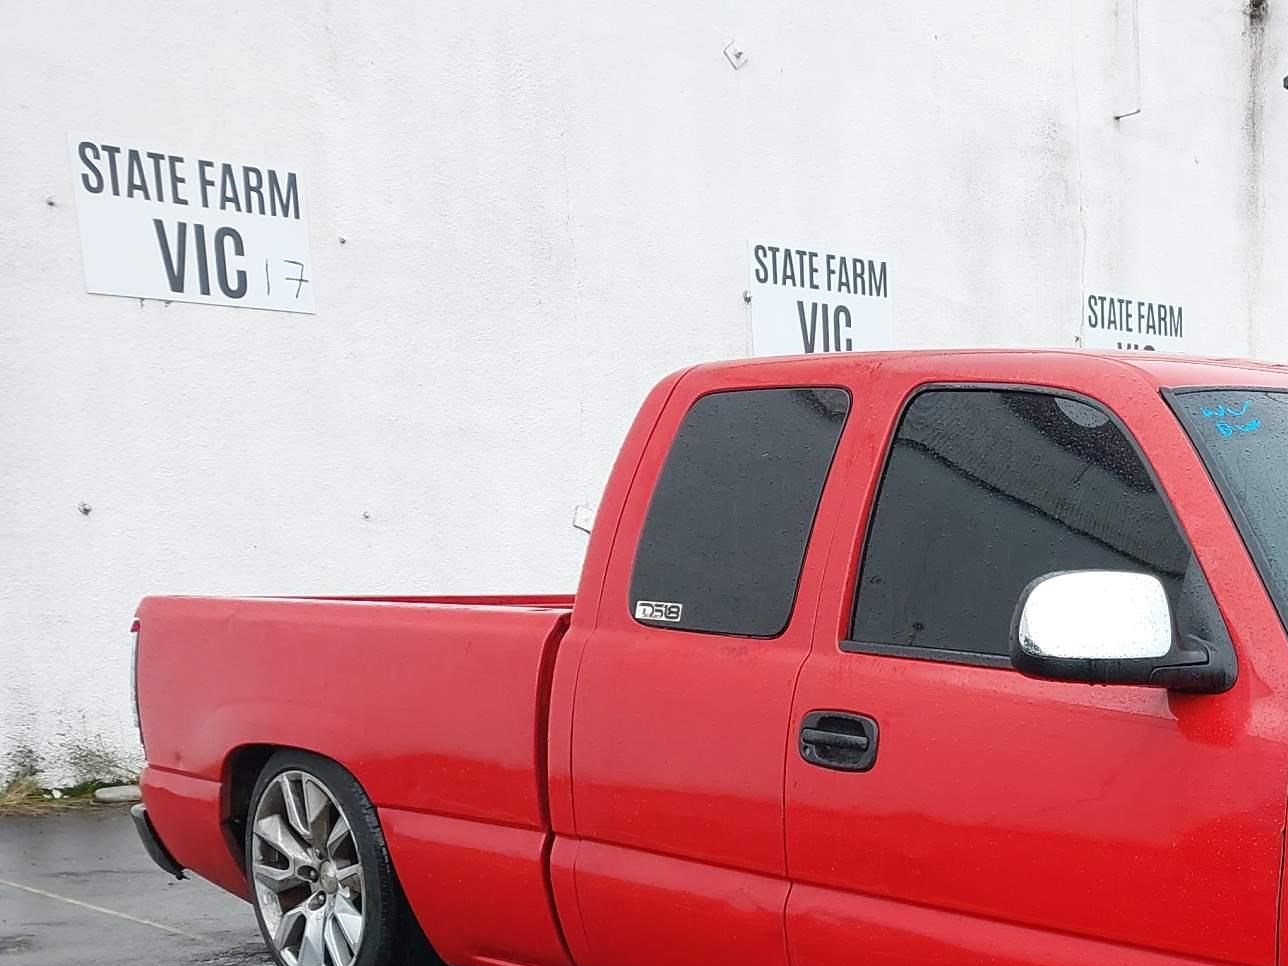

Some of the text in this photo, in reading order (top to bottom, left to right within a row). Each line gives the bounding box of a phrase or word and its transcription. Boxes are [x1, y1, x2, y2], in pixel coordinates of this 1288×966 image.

[78, 141, 301, 220] STATE FARM
[153, 218, 248, 300] VIC
[265, 258, 310, 299] 17
[754, 244, 888, 298] STATE FARM
[797, 300, 853, 354] VIC
[1087, 294, 1183, 338] STATE FARM
